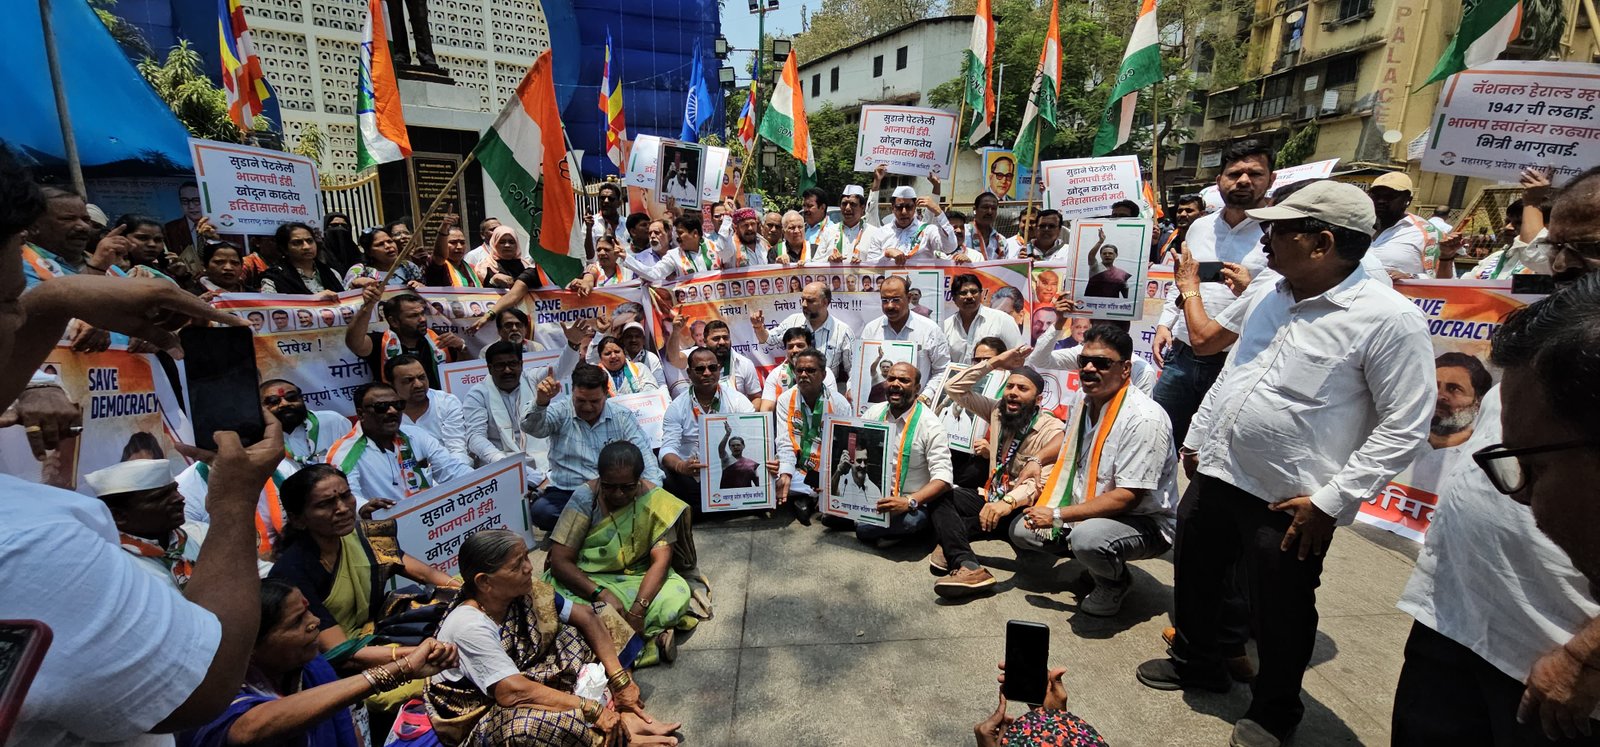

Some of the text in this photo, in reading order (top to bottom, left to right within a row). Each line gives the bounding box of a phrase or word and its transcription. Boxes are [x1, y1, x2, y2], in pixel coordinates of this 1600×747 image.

[1472, 80, 1528, 95] नॅशनल
[1529, 82, 1575, 98] हेराल्ड
[1488, 101, 1595, 120] 1947 ची लढाई.
[884, 114, 935, 126] सुडाने पेटलेली
[1447, 117, 1489, 130] भाजप
[1491, 119, 1547, 134] स्वातंत्र्य
[884, 126, 930, 137] भाजपची ईडी.
[880, 135, 932, 148] खोदून काढतेय
[1476, 134, 1579, 157] भित्री भागूबाई.
[873, 145, 936, 160] इतिहासातली मढी.
[229, 156, 295, 173] सुडाने पेटलेली
[1066, 164, 1116, 177] सुडाने पेटलेली
[1461, 156, 1493, 168] महाराष्ट्र
[1495, 159, 1516, 170] प्रदेश
[236, 171, 296, 187] भाजपची ईडी.
[1069, 173, 1116, 185] भाजपची ईडी.
[235, 185, 300, 201] खोदून काढतेय
[1067, 182, 1119, 196] खोदून काढतेय
[1061, 191, 1126, 206] इतिहासातली मढी.
[228, 199, 309, 216] इतिहासातली मढी.
[535, 298, 561, 312] SAVE
[720, 305, 741, 317] निषेध
[774, 300, 796, 311] निषेध
[1408, 298, 1446, 316] AVE
[537, 306, 599, 324] DEMOCRACY
[1427, 319, 1501, 341] OCRACY
[278, 339, 312, 355] निषेध
[328, 358, 369, 378] मोदी
[88, 368, 118, 391] SAVE
[91, 393, 160, 419] DEMOCRACY
[420, 478, 498, 527] सुडाने पेटलेली
[428, 499, 497, 541] भाजपची ईडी.
[425, 533, 461, 561] खोदून
